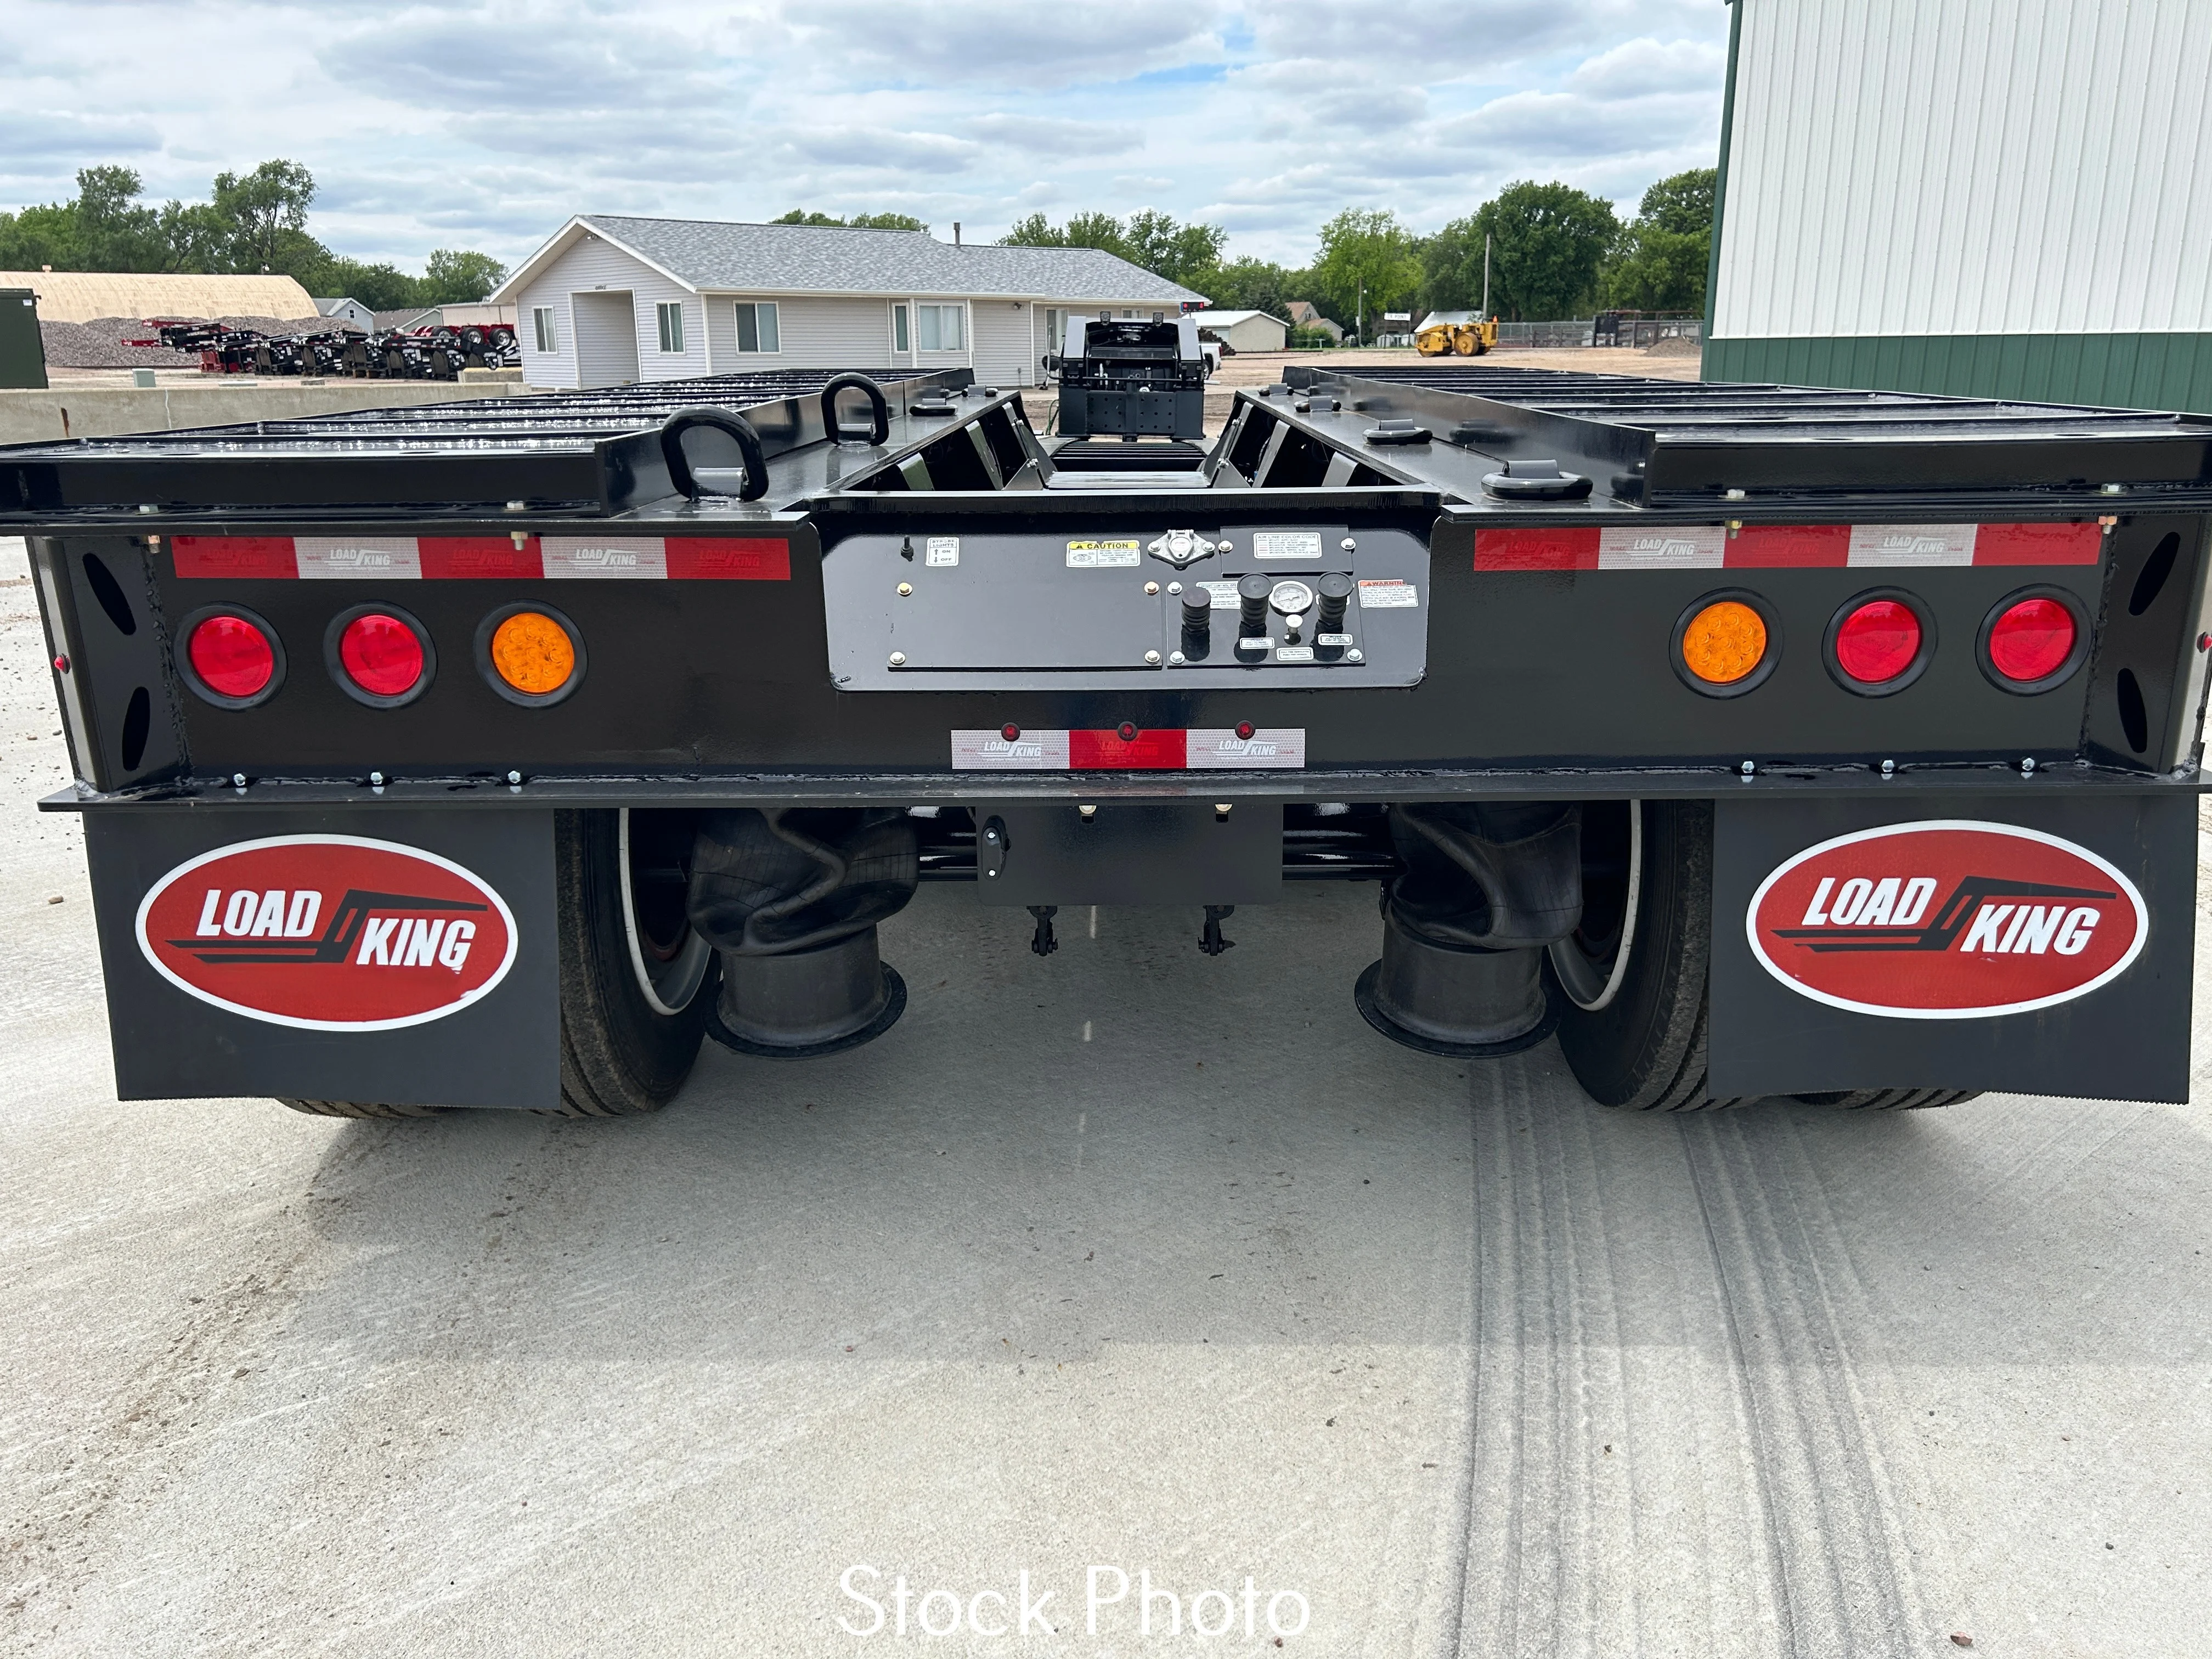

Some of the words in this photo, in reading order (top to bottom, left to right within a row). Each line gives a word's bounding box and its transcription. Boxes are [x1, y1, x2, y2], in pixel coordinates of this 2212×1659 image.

[1633, 539, 1662, 549] LOAD
[1666, 544, 1695, 555] KING
[1883, 537, 1912, 547] LOAD
[1916, 541, 1945, 553] KING
[330, 549, 357, 560] LOAD
[364, 555, 391, 566] KING
[575, 549, 603, 560] LOAD
[609, 555, 636, 566] KING
[984, 741, 1010, 751] LOAD
[1015, 746, 1042, 757] KING
[1133, 746, 1159, 756] KING
[1218, 740, 1245, 750] LOAD
[1250, 745, 1277, 755] KING
[1802, 877, 1937, 926] LOAD
[1960, 904, 2100, 955] KING
[196, 889, 323, 938] LOAD
[356, 917, 476, 968] KING
